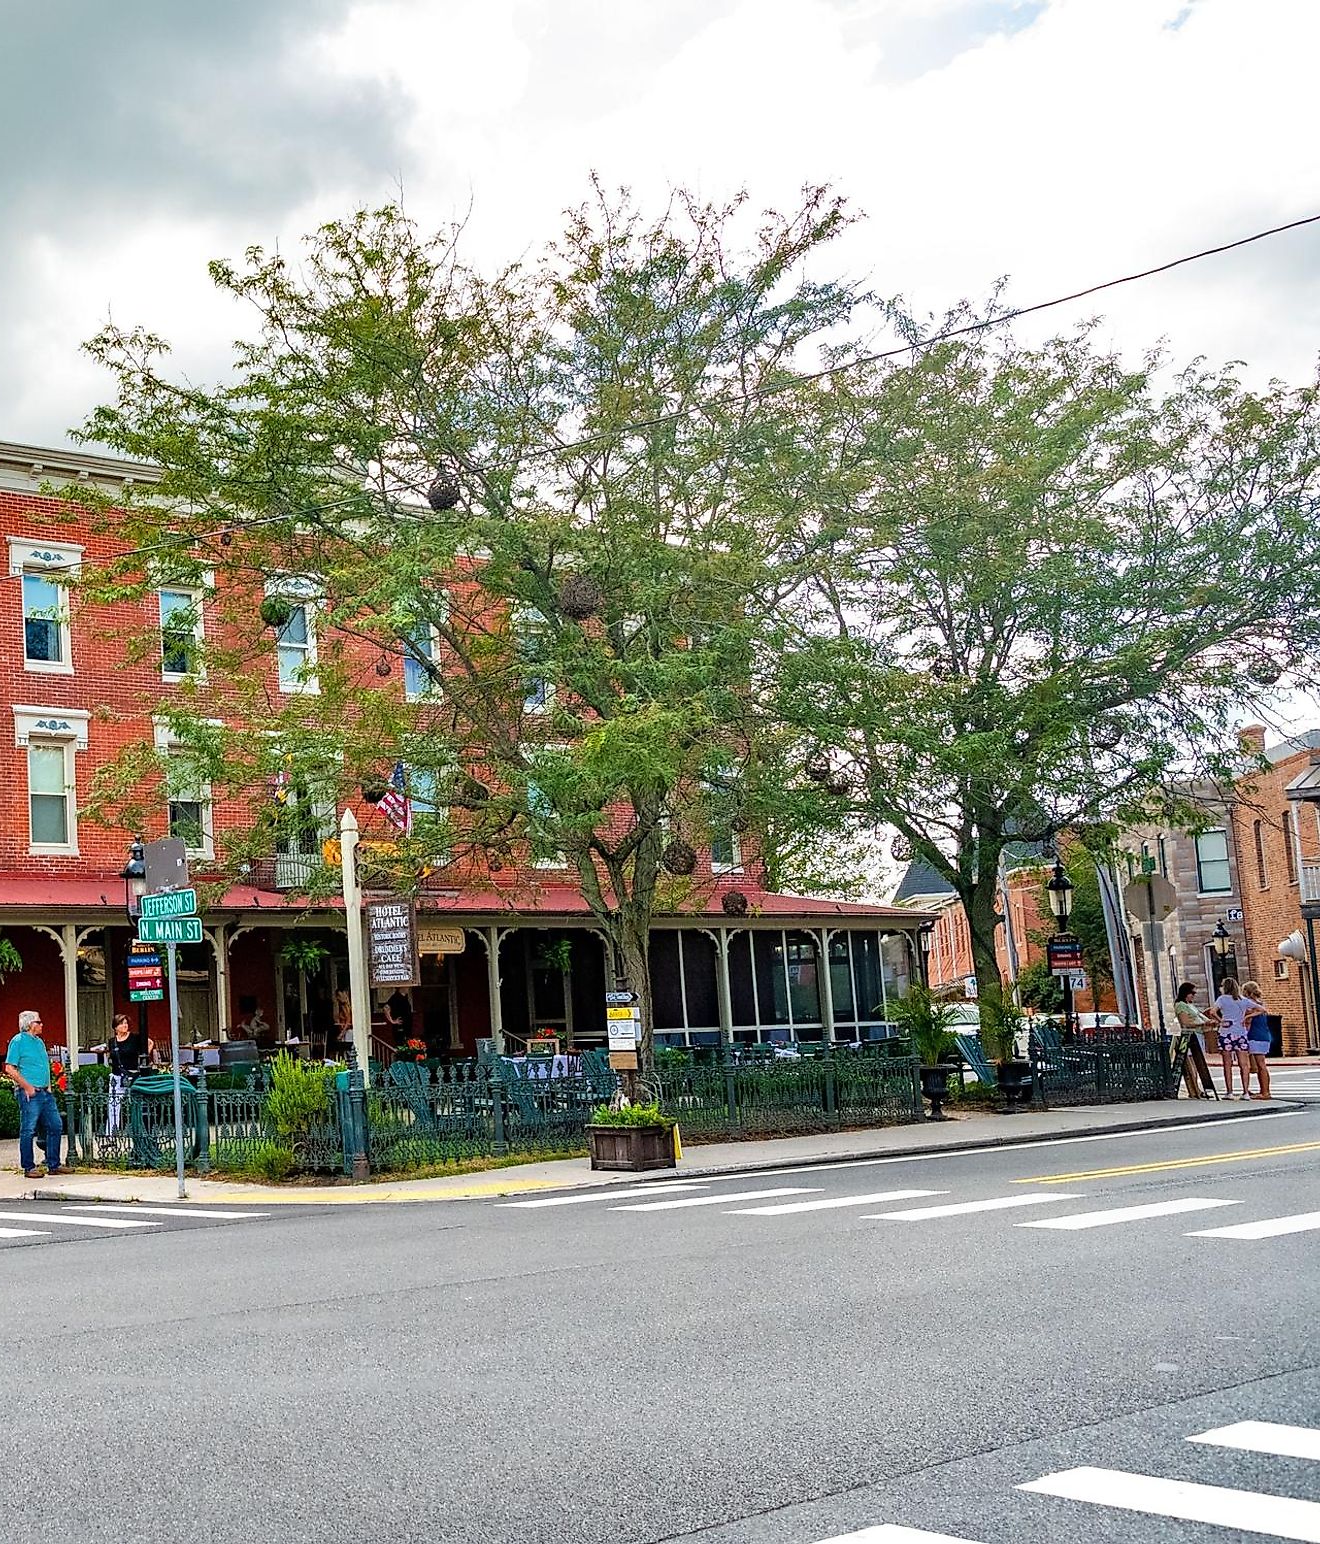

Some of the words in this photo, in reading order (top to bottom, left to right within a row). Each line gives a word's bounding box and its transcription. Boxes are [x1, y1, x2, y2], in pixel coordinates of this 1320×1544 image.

[144, 894, 183, 916] JEFFERSON
[184, 892, 192, 912] ST
[375, 906, 403, 917] HOTEL
[372, 916, 409, 929] ATLANTIC
[141, 921, 152, 940] N.
[155, 921, 183, 940] MAIN
[186, 921, 199, 940] ST
[132, 946, 155, 954] BERLIN
[1070, 978, 1084, 989] 74
